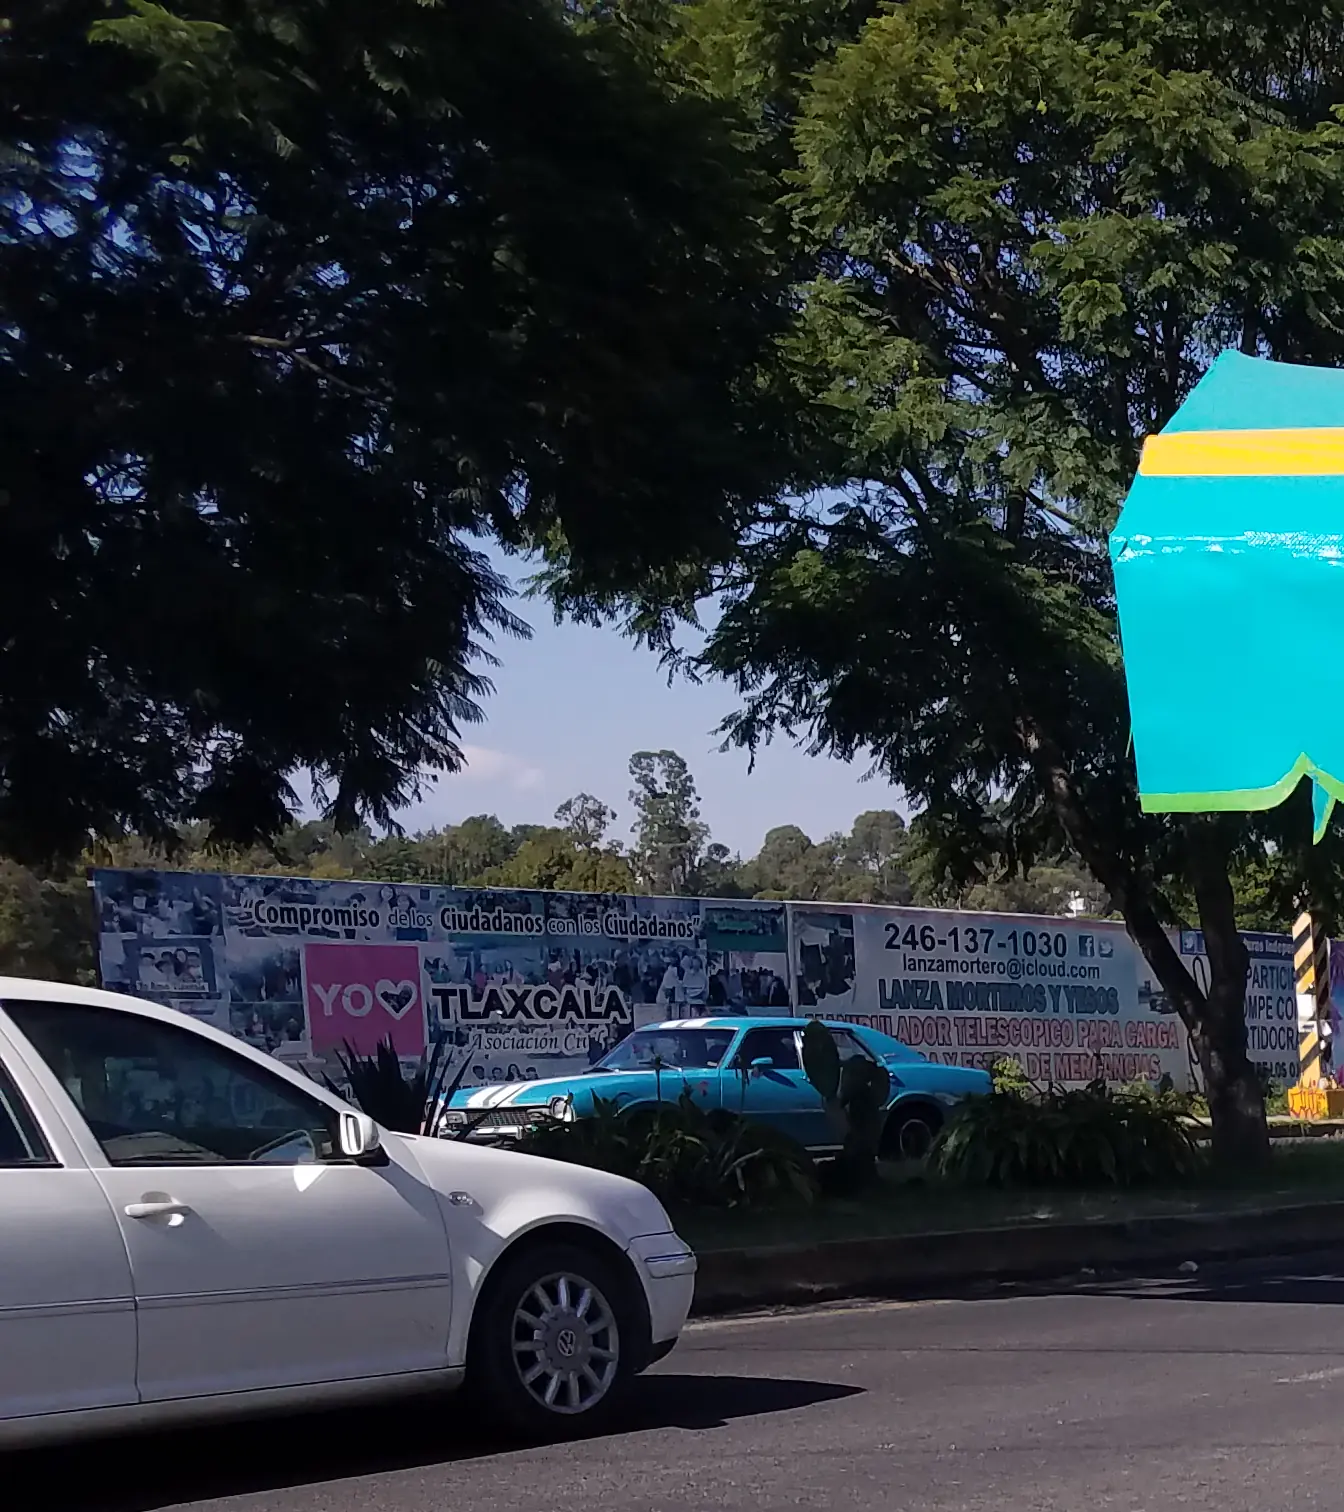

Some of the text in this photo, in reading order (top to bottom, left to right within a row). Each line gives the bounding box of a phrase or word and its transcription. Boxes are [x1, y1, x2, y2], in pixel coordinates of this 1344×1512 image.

[409, 907, 433, 928] los
[440, 905, 543, 934] Ciudadanos
[548, 917, 576, 934] con
[579, 914, 601, 935] los
[884, 922, 1068, 959] 246-137-1030
[902, 953, 1101, 980] lanzamortero@icloud.com
[312, 983, 374, 1017] YO
[432, 987, 627, 1020] TLAXCALA
[878, 978, 944, 1010] LANZA
[471, 1031, 559, 1052] Asociación
[954, 1016, 1075, 1048] TELESCOPICO
[1077, 1018, 1124, 1049] PARA
[1124, 1020, 1179, 1050] CARGA
